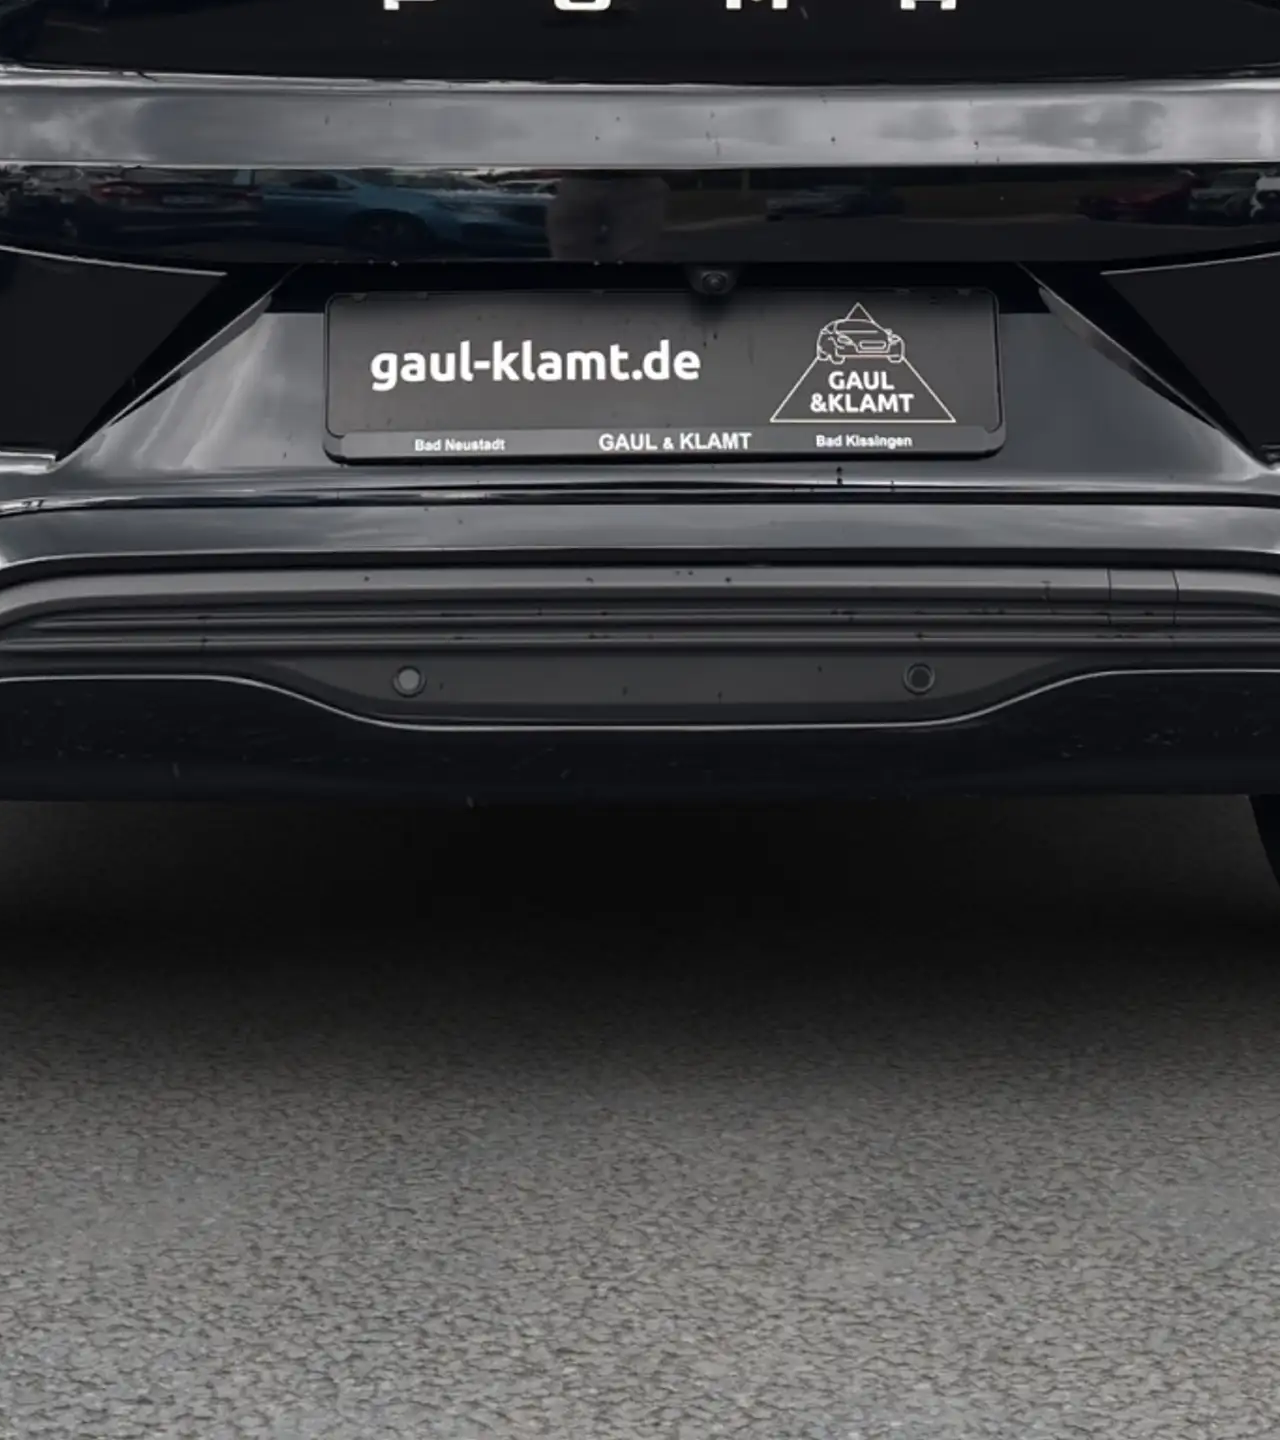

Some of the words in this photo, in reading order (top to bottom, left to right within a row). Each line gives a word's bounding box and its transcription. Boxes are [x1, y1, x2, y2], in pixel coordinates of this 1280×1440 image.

[370, 338, 702, 392] gaul-klamt.de
[827, 370, 896, 391] GAUL
[809, 392, 915, 414] &KLAMT
[414, 438, 441, 452] Bad
[445, 437, 506, 452] Neustadt
[598, 432, 659, 452] GAUL
[662, 437, 675, 451] &
[679, 431, 753, 452] KLAMT
[815, 434, 843, 448] Bad
[846, 433, 913, 452] Kissingen
